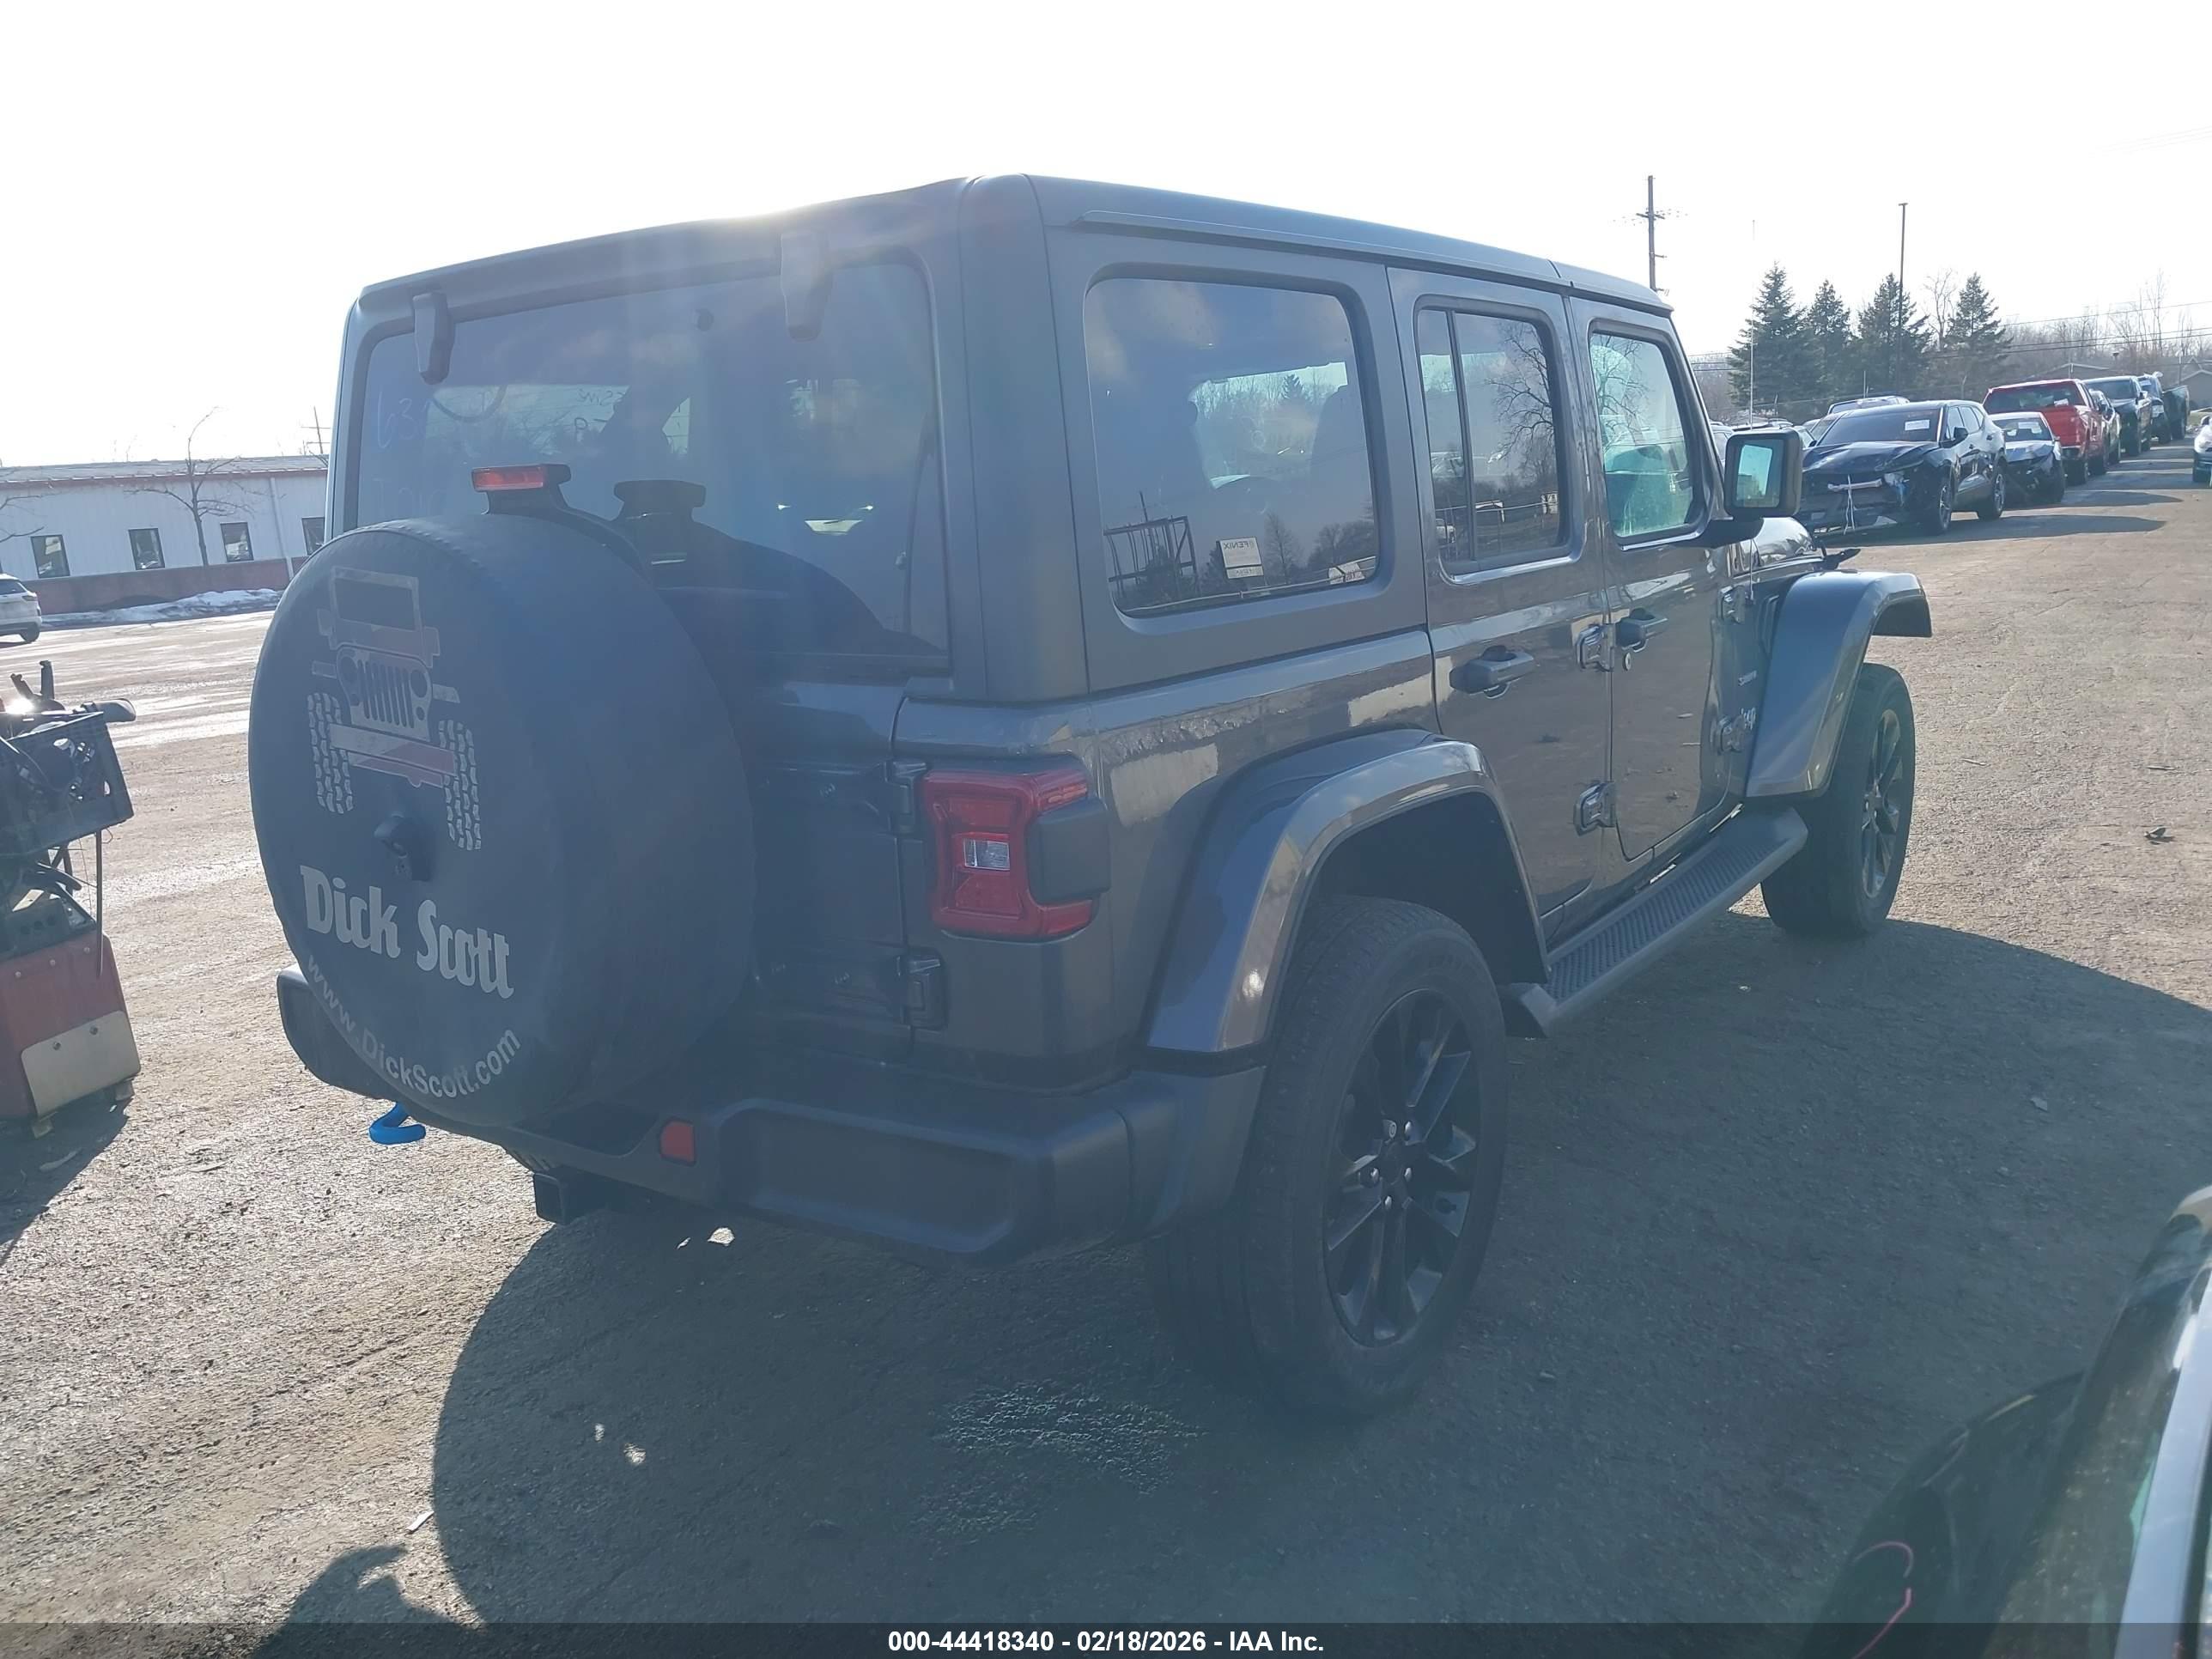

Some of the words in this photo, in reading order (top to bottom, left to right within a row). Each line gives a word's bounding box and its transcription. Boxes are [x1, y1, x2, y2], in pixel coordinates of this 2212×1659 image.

[300, 865, 401, 958] Dick
[416, 899, 514, 999] Scott
[307, 954, 522, 1100] www.DickScott.com
